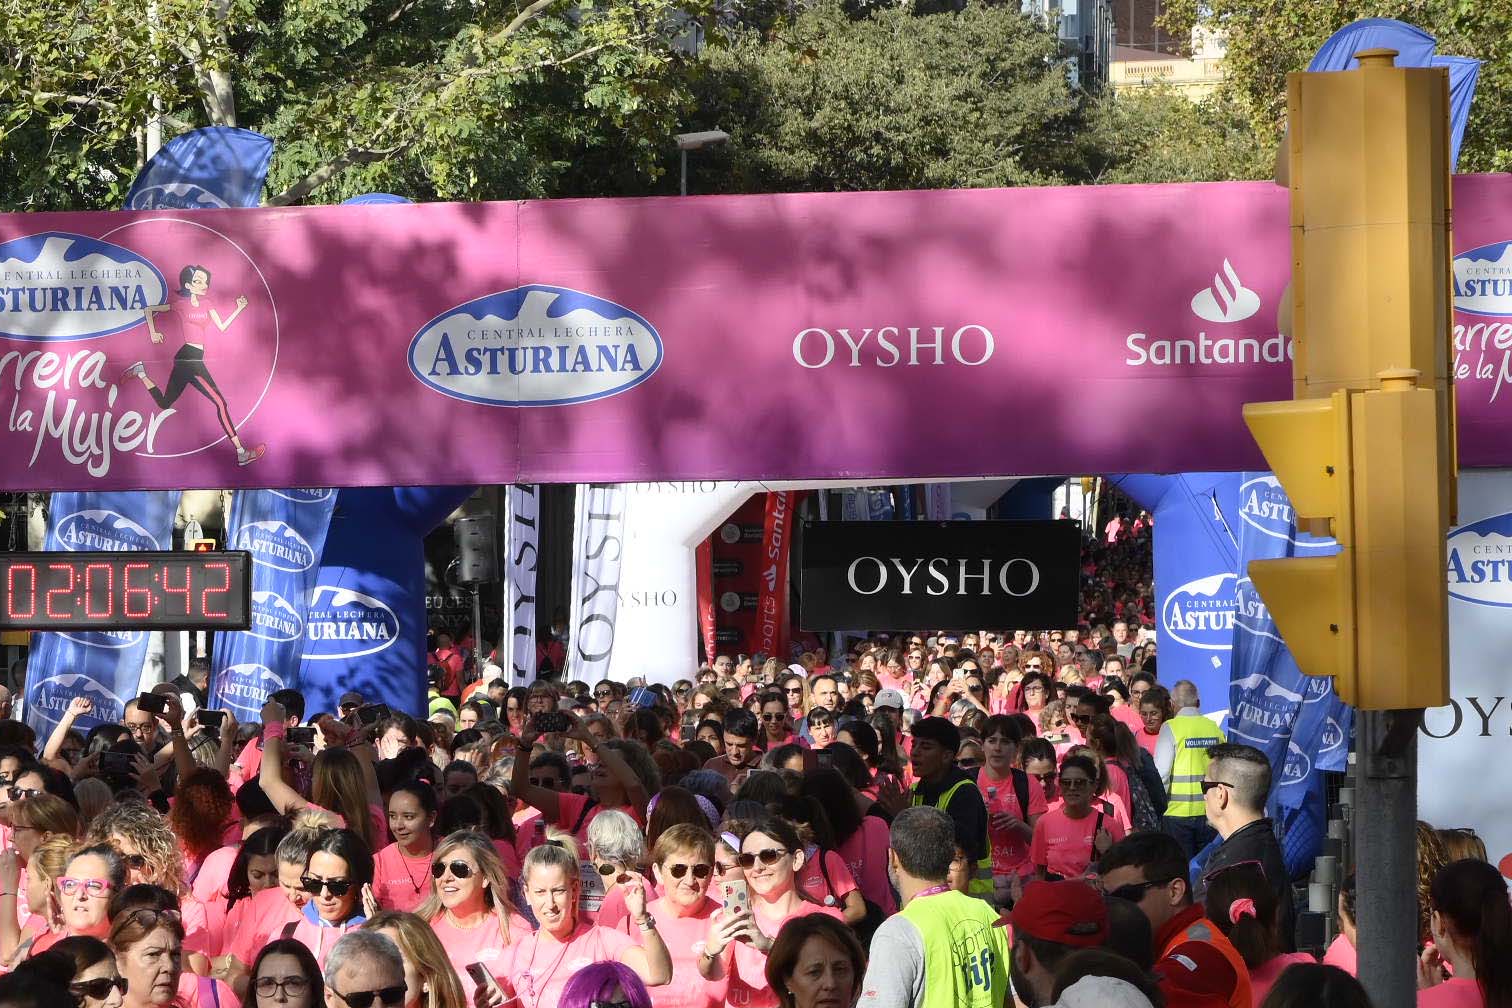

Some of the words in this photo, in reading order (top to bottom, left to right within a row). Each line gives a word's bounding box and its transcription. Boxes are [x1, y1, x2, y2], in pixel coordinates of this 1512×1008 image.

[70, 267, 142, 281] LECHERA
[467, 327, 546, 341] CENTRAL
[554, 324, 635, 339] LECHERA
[792, 324, 995, 369] OYSHO
[428, 332, 645, 377] ASTURIANA
[8, 391, 33, 432] la
[28, 384, 178, 478] Mujer
[238, 531, 308, 566] ASTURIANA
[7, 562, 230, 619] 02:06:42
[846, 556, 1041, 597] OYSHO
[307, 621, 390, 640] URIANA
[37, 688, 119, 724] ASTUANA
